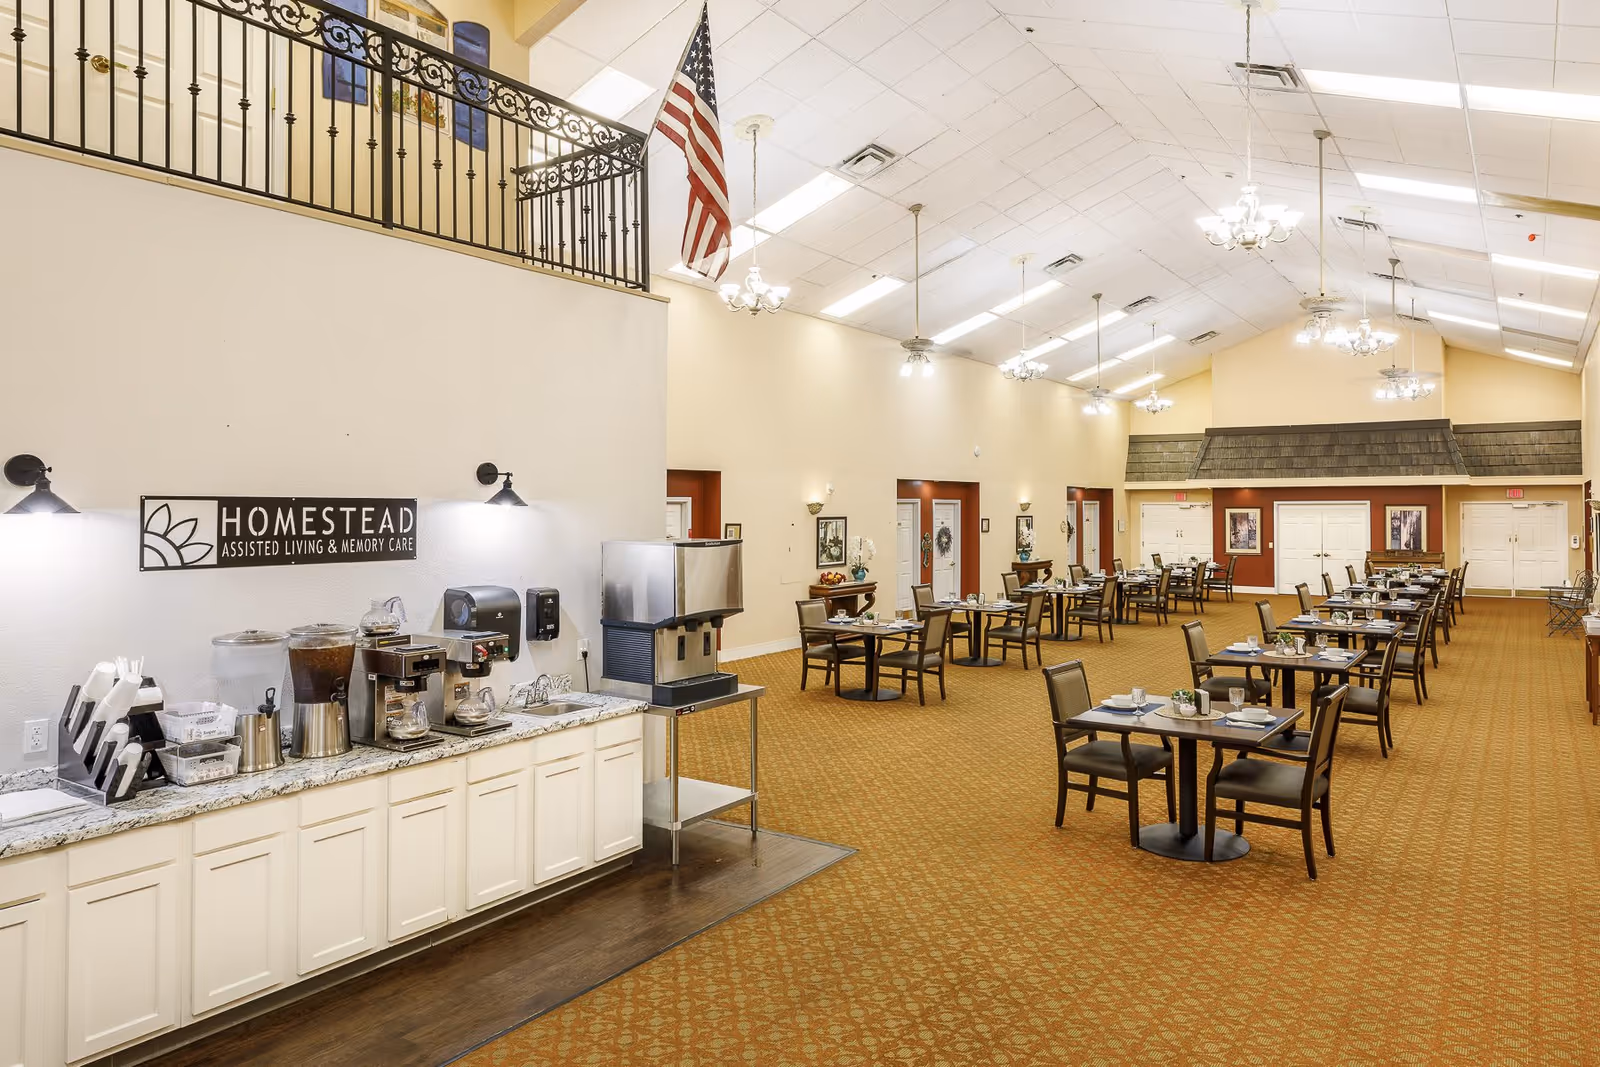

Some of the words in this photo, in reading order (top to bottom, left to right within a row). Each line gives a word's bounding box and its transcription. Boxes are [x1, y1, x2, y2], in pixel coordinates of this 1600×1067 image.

[221, 506, 413, 537] HOMESTEAD
[221, 540, 279, 557] ASSISTED
[285, 538, 324, 555] LIVING
[327, 540, 338, 553] &
[341, 538, 384, 553] MEMORY
[388, 537, 413, 551] CARE
